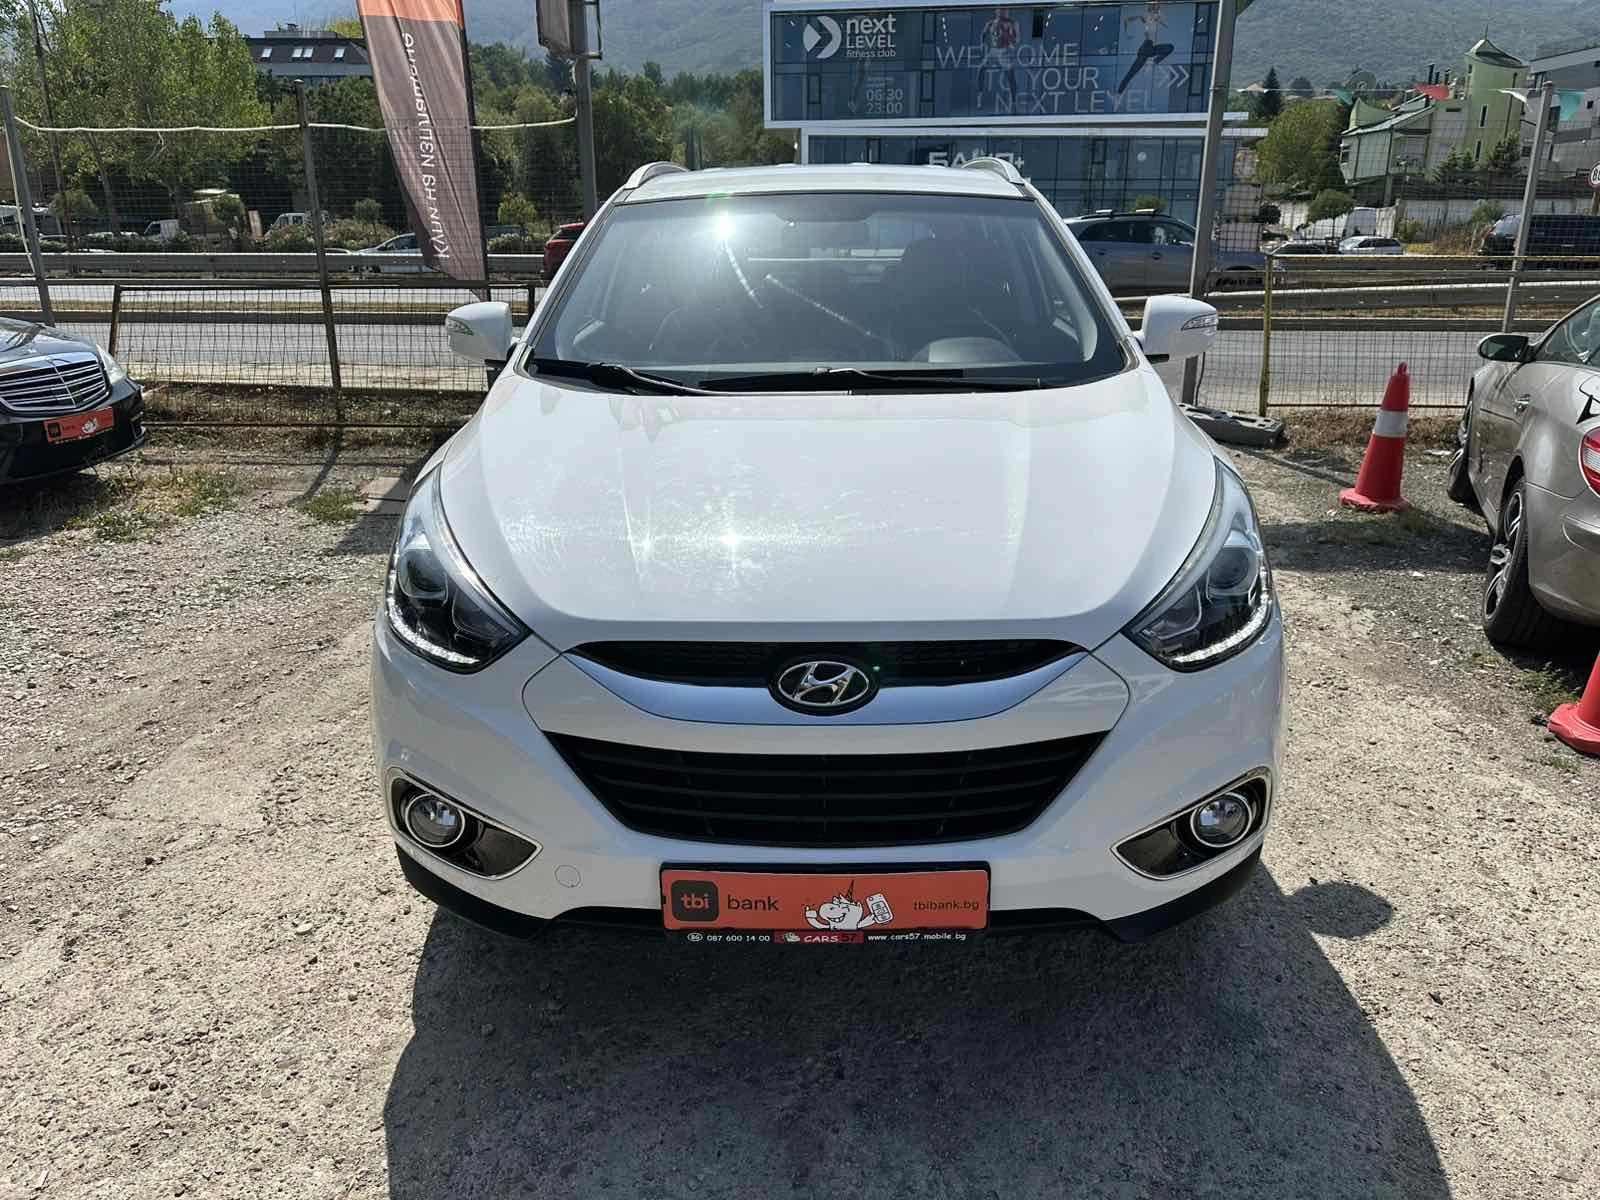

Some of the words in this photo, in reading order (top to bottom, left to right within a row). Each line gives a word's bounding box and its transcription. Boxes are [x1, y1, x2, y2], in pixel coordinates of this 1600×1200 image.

[846, 13, 896, 34] next
[846, 35, 896, 48] LEVEL
[877, 48, 897, 57] club
[936, 43, 1080, 68] WEOME
[1027, 67, 1099, 90] YOUR
[865, 102, 904, 115] 23:00
[995, 91, 1065, 114] NEXT
[1074, 89, 1157, 113] LEVEL
[681, 893, 709, 909] tbi
[727, 895, 779, 911] bank
[913, 900, 979, 912] tbibank.bg
[867, 932, 968, 941] www.cars57.mobile.bg
